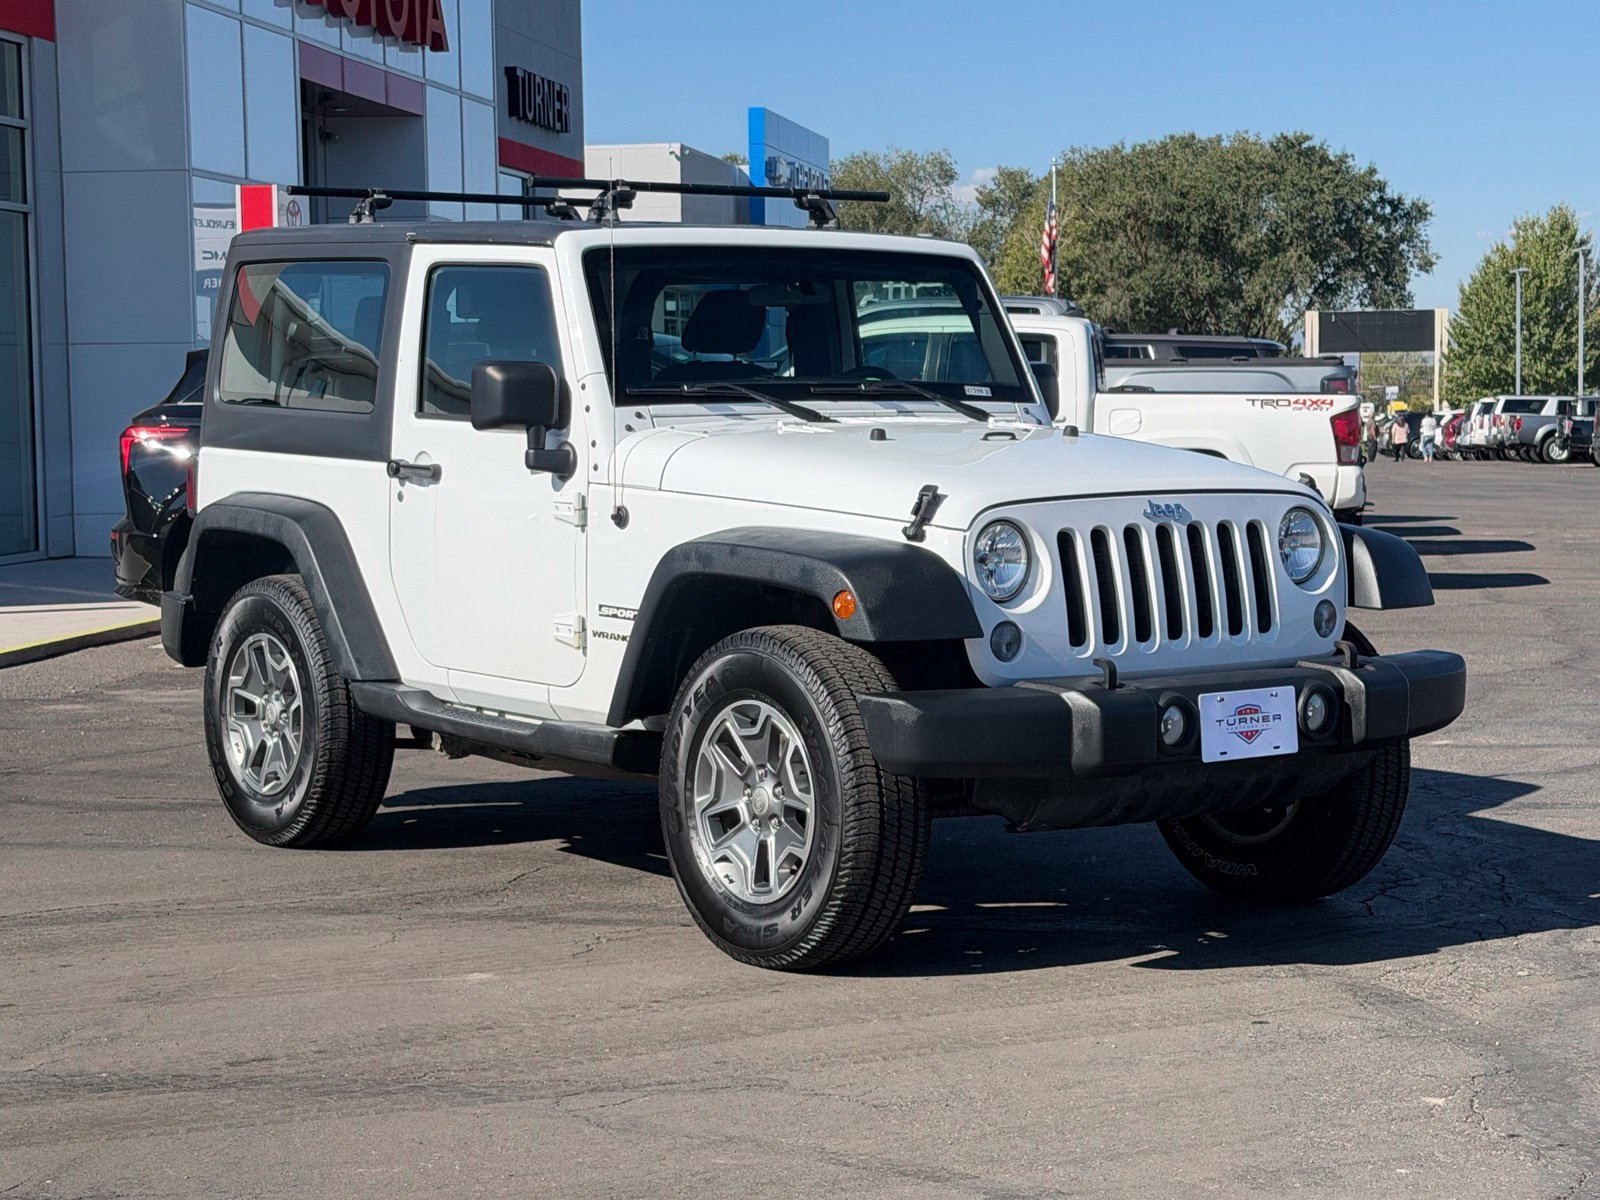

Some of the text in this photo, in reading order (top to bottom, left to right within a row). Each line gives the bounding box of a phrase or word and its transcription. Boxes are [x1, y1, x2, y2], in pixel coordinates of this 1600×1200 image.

[319, 0, 449, 52] OTA
[512, 66, 571, 133] TURNER
[1143, 499, 1183, 521] Jeep
[1215, 713, 1282, 728] TURNER
[664, 664, 738, 834] GOODYEAR
